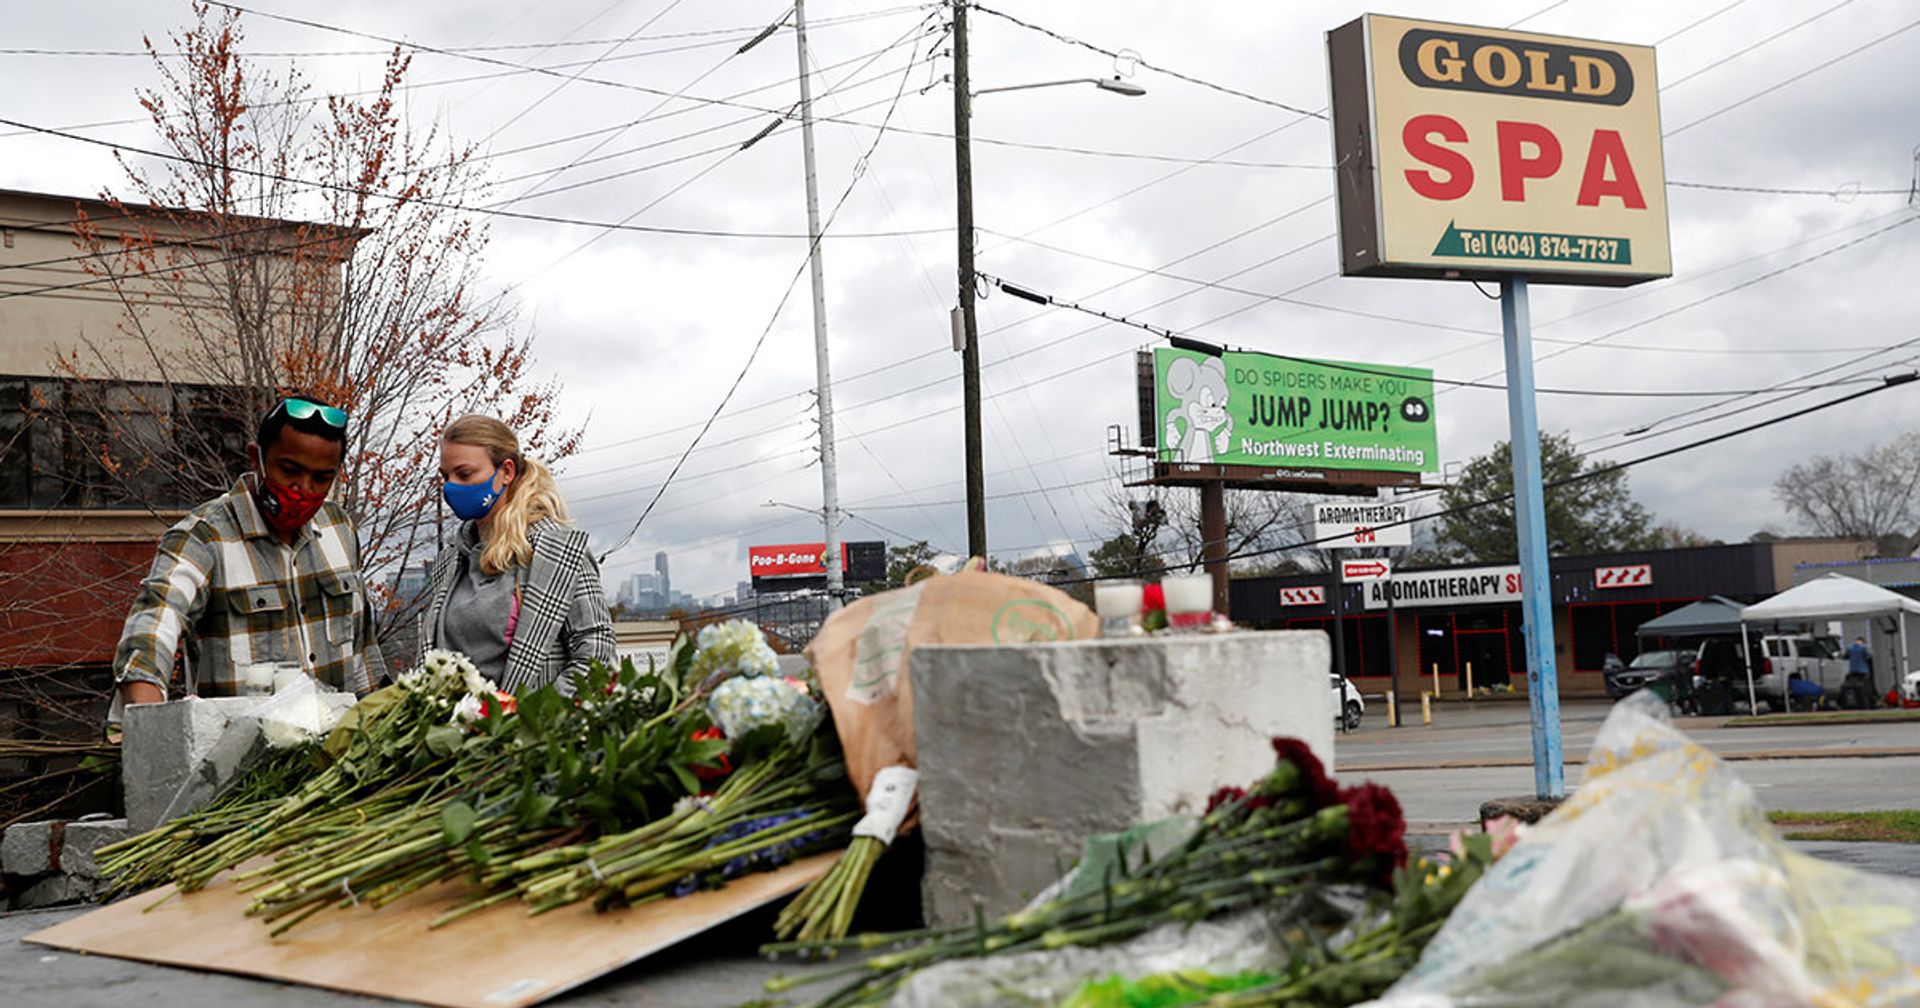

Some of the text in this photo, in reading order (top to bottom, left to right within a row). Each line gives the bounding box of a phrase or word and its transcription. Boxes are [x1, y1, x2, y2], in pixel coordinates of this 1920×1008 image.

[1416, 38, 1617, 97] GOLD
[1402, 114, 1648, 211] SPA
[1459, 231, 1619, 261] Tel (404) 874-7737
[1234, 368, 1408, 396] DO SPIDERS MAKE YOU
[1249, 393, 1391, 433] JUMP JUMP?
[1241, 437, 1425, 465] Northwest Exterminating
[1318, 506, 1406, 525] AROMATHERAPY
[1354, 526, 1376, 544] SPA
[751, 552, 817, 567] Poo-B-Gone
